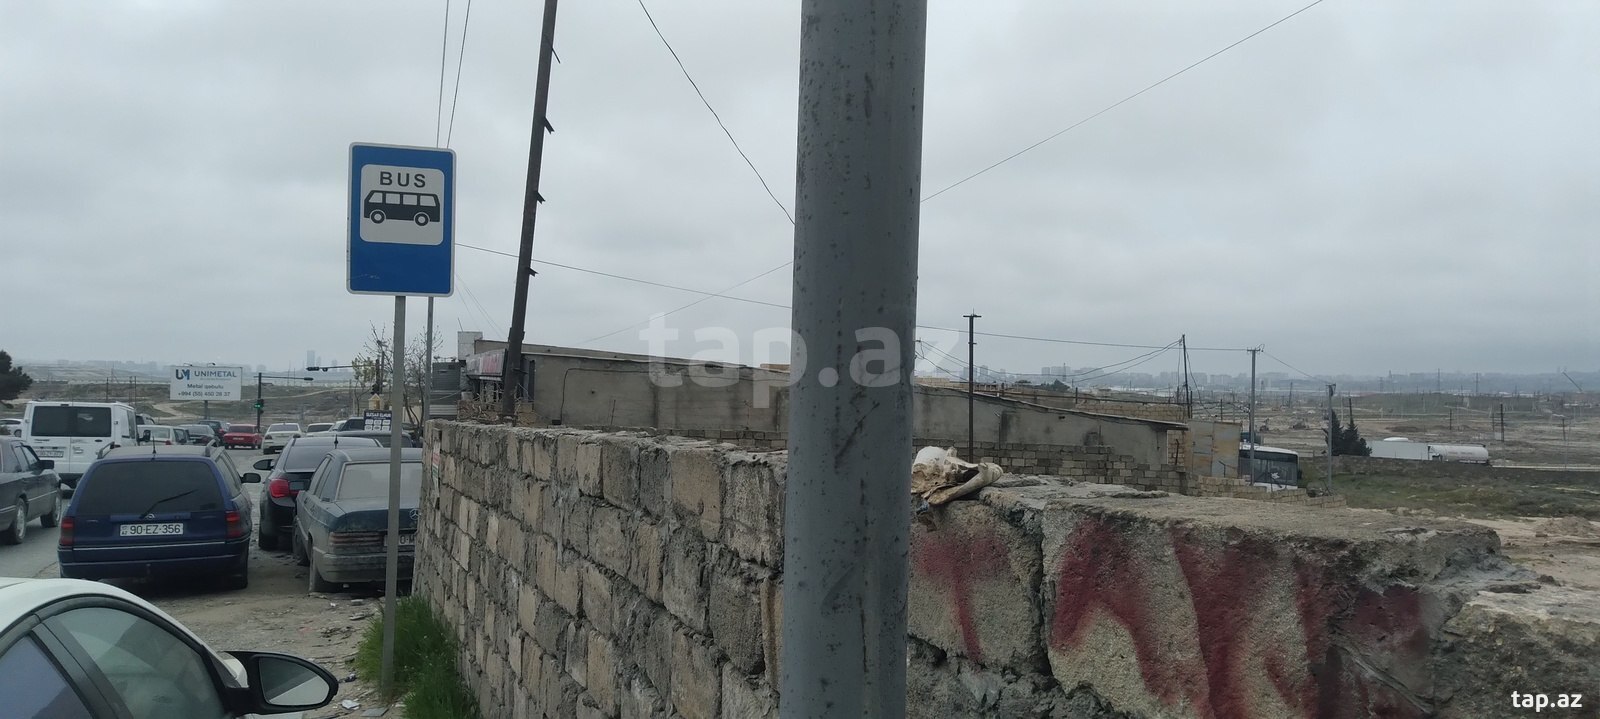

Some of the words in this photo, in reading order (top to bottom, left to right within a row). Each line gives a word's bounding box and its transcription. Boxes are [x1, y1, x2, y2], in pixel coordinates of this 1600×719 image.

[380, 171, 426, 188] BUS
[194, 370, 237, 378] UNIMETAL
[129, 524, 181, 535] 90-EZ-356
